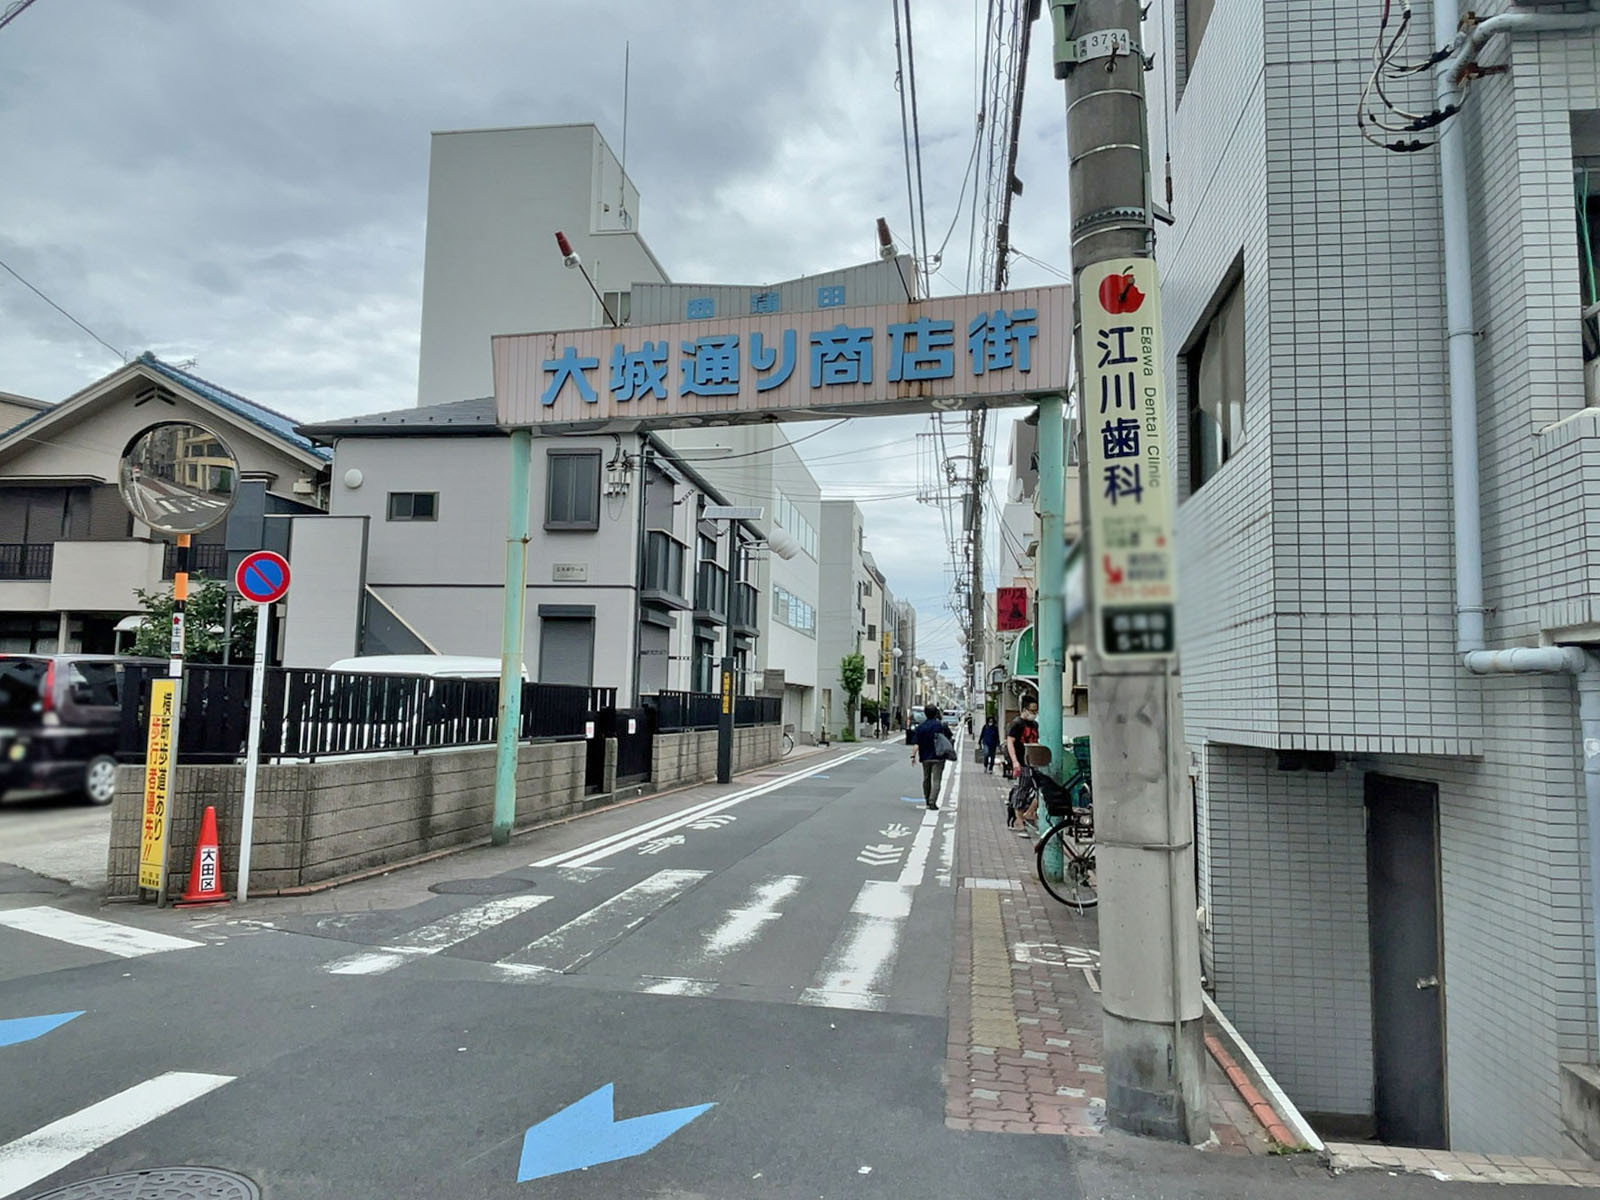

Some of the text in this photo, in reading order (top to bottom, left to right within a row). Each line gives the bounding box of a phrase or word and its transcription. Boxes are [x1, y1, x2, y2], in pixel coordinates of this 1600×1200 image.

[1091, 33, 1127, 47] 3734
[541, 307, 1038, 406] 大城通り商店街
[1097, 325, 1143, 505] 江川歯科
[1140, 326, 1161, 488] Egawa Dental Clinic
[201, 848, 216, 891] 大田区
